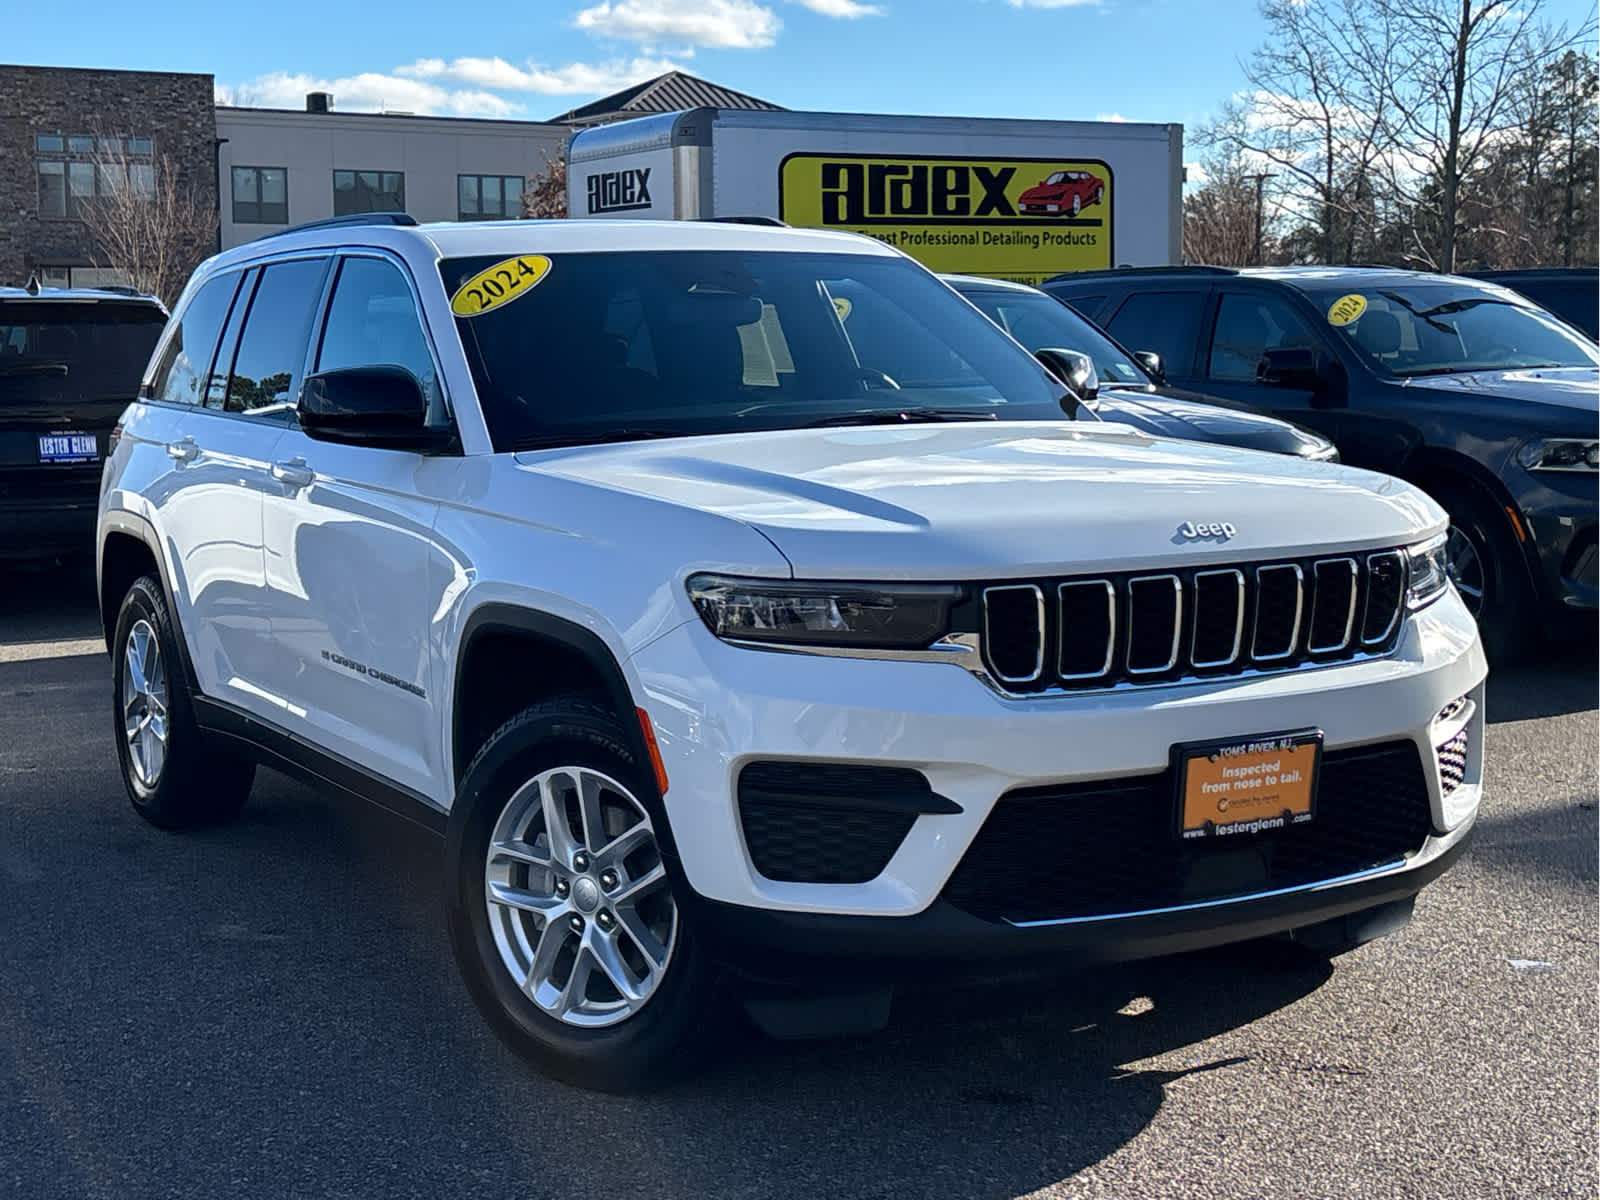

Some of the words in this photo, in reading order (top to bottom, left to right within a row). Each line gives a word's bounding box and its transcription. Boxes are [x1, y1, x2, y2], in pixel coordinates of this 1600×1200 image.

[901, 230, 980, 246] Professional
[983, 231, 1039, 249] Detailing
[1043, 232, 1097, 246] Products
[467, 260, 535, 309] 2024
[1334, 297, 1361, 322] 2024
[39, 438, 69, 455] LESTER
[1183, 521, 1236, 538] Jeep
[1219, 744, 1246, 757] TOMS
[1222, 760, 1280, 778] Inspected
[1202, 782, 1230, 794] from
[1234, 777, 1262, 790] nose
[1265, 774, 1277, 785] to
[1280, 770, 1302, 783] tail.
[1215, 817, 1284, 836] lesterglenn
